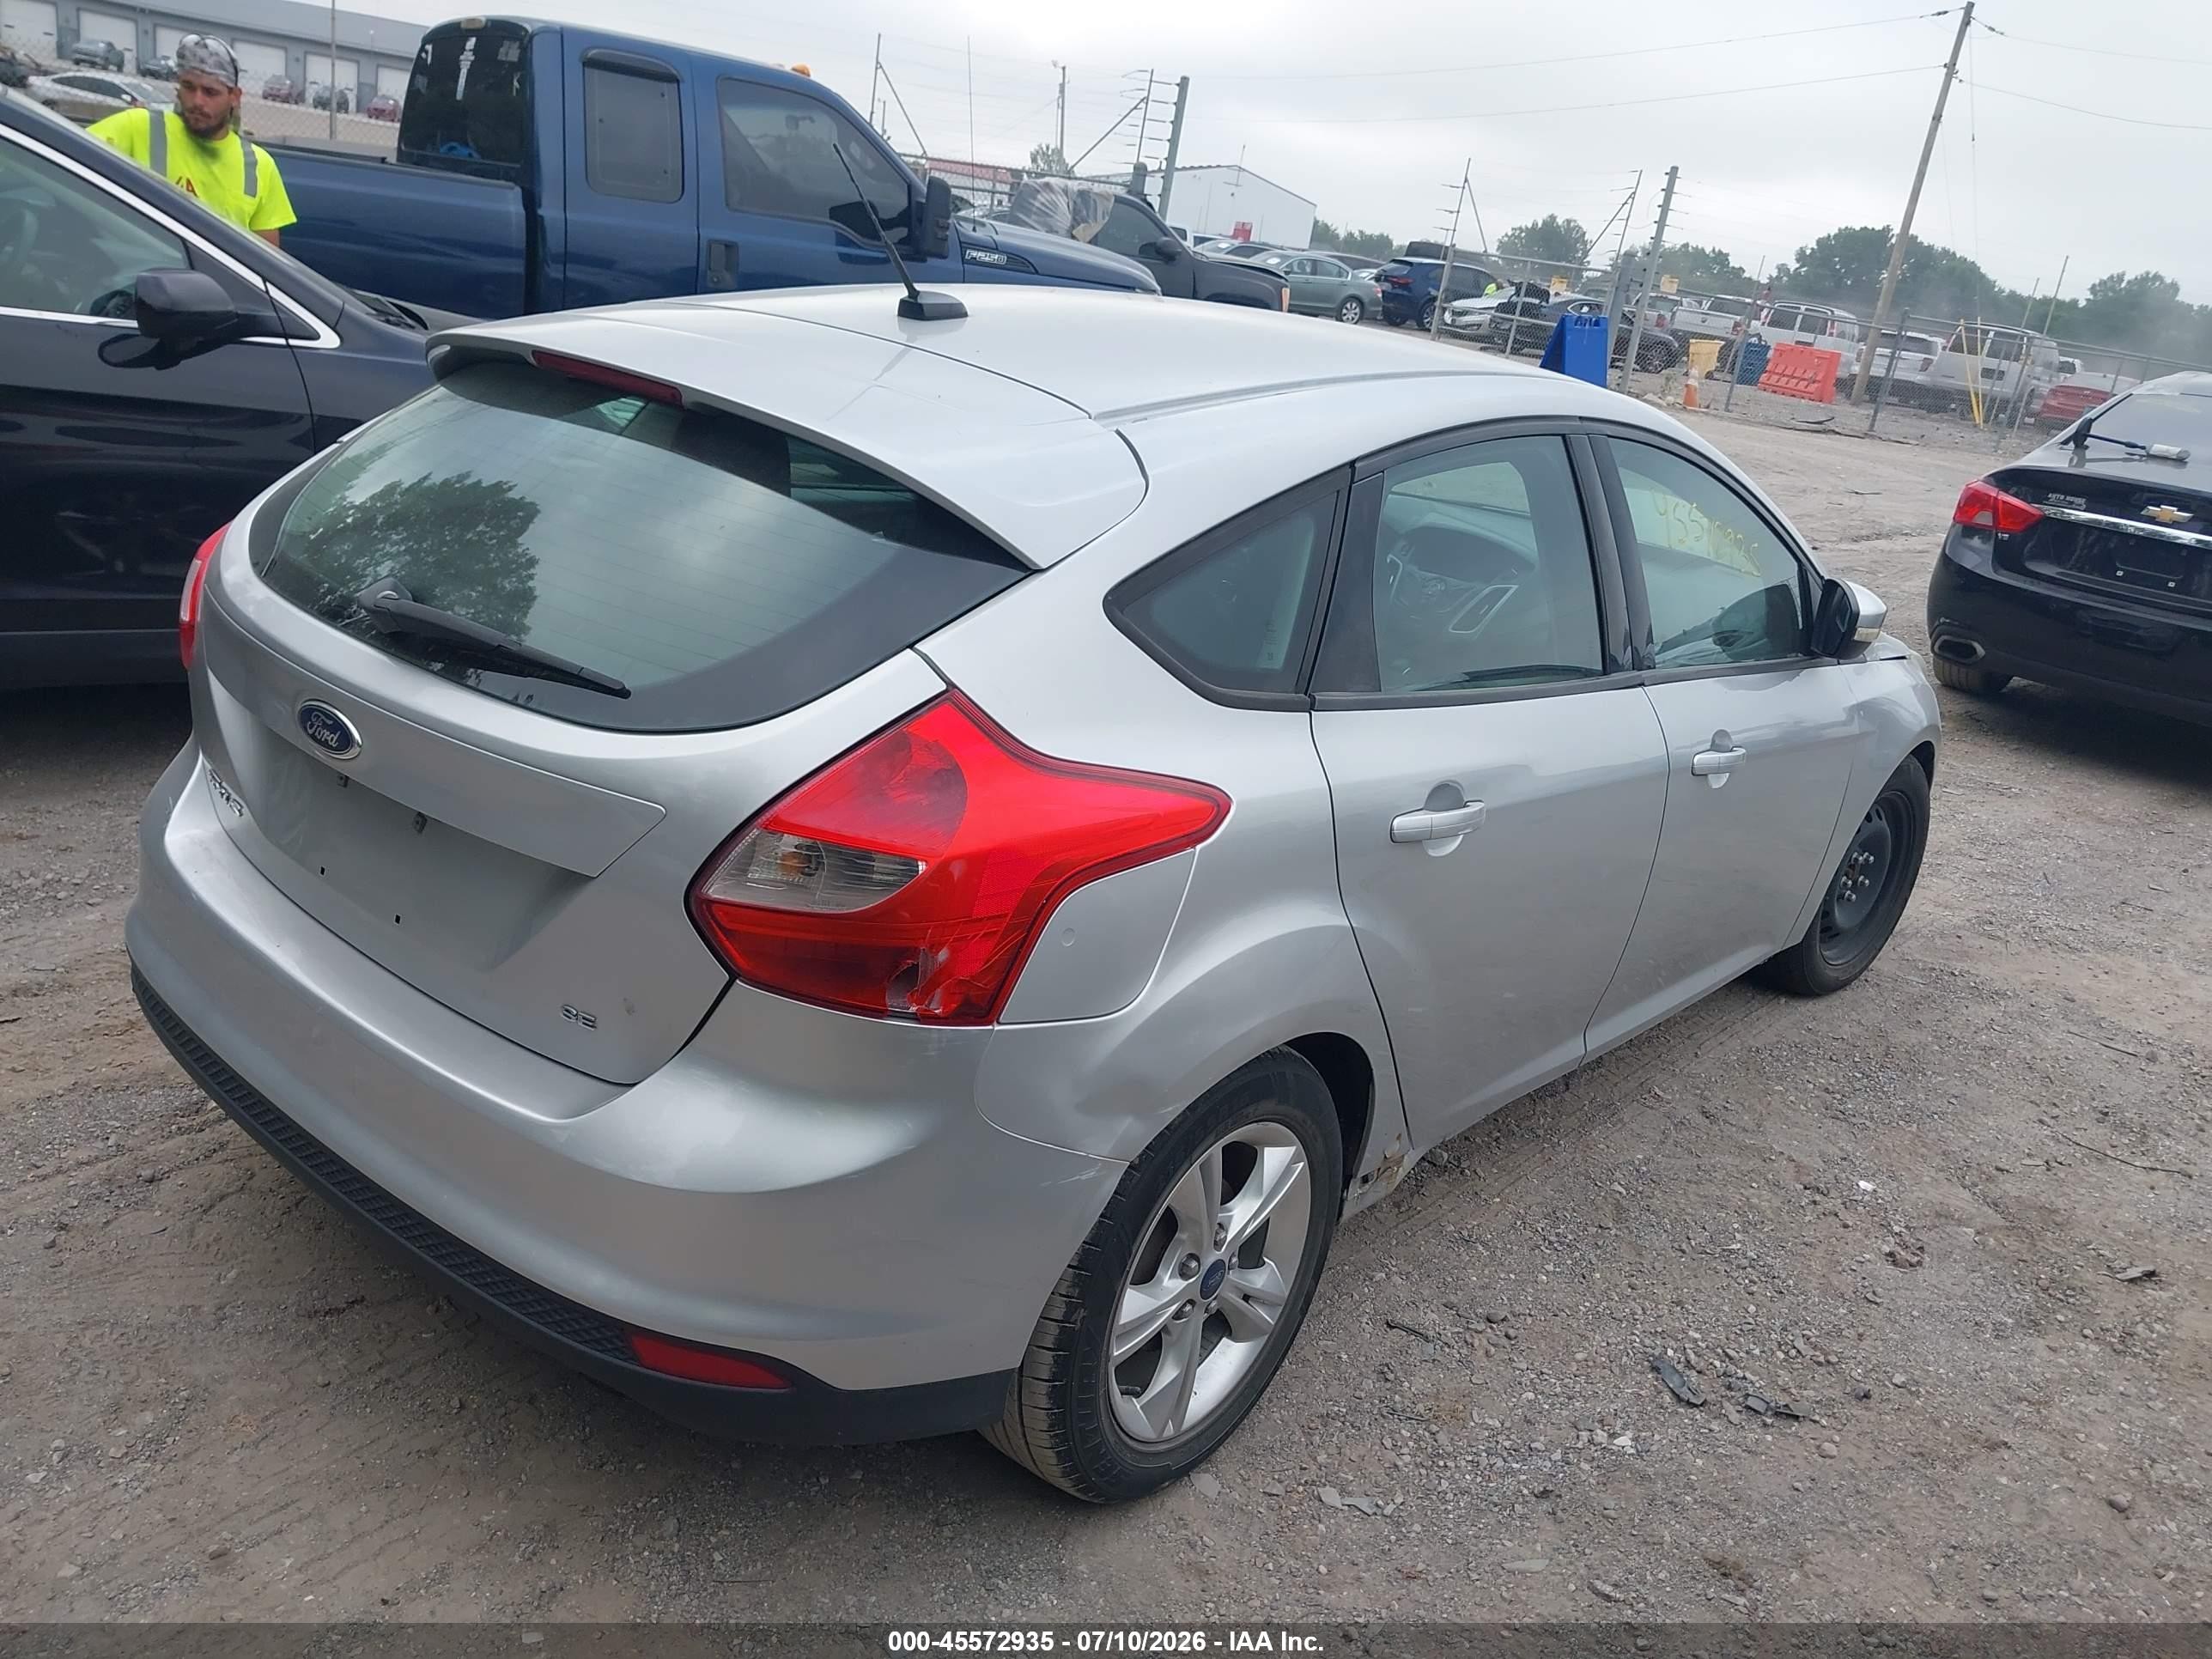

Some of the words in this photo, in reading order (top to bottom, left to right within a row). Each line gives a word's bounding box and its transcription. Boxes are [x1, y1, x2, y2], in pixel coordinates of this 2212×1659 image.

[965, 249, 1007, 264] F250
[307, 712, 340, 746] Ford
[561, 1005, 597, 1030] SE
